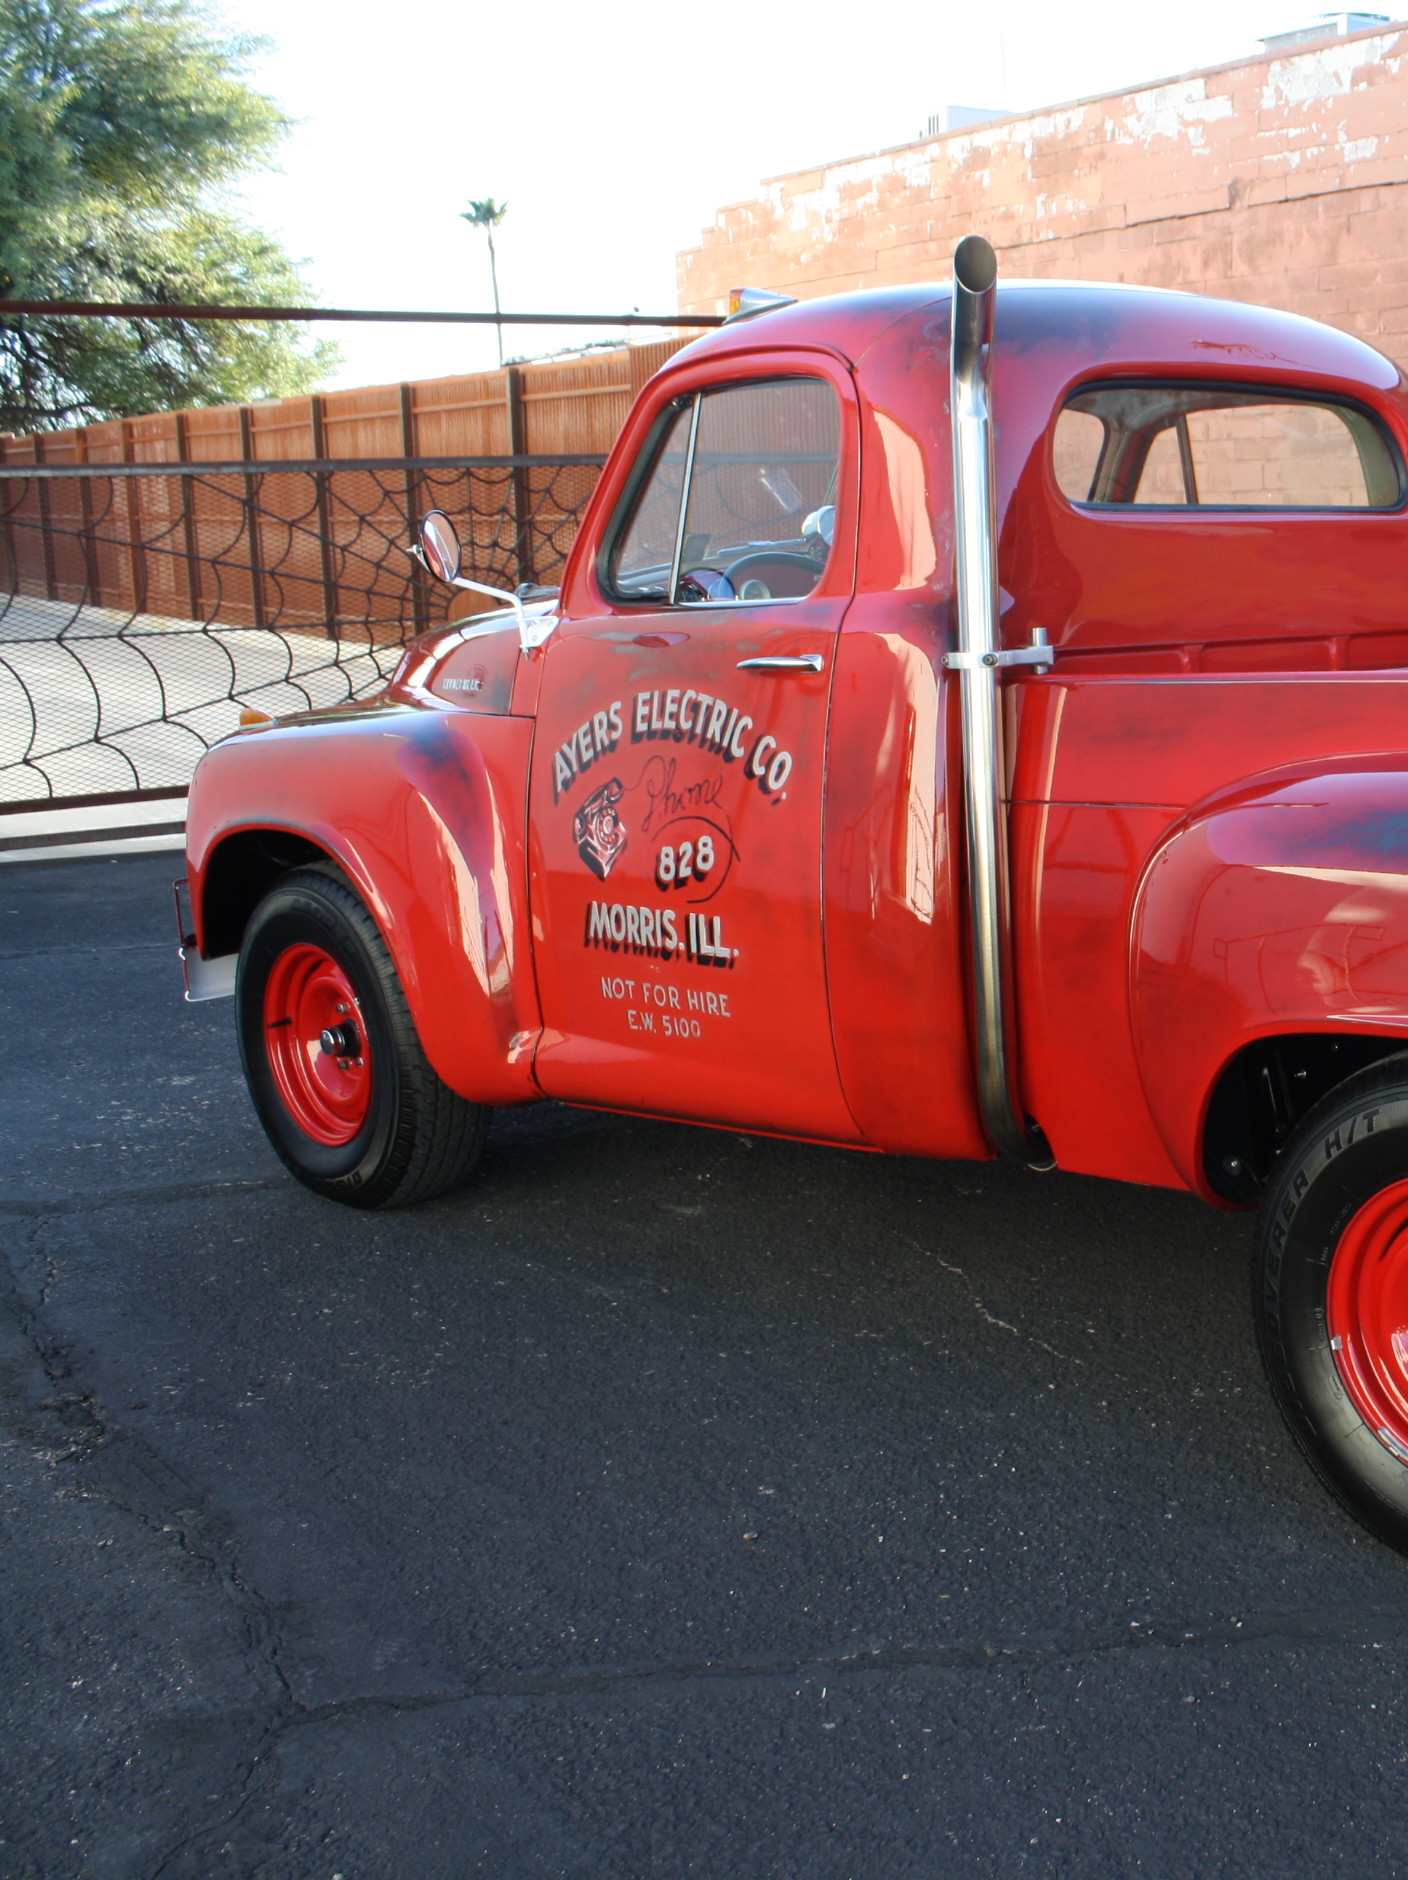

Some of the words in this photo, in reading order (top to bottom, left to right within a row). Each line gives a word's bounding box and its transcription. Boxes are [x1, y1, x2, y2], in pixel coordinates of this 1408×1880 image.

[552, 701, 623, 800] AYERS
[632, 689, 753, 763] ELECTRIC
[748, 735, 793, 802] CO.
[656, 834, 715, 890] 828
[688, 912, 741, 968] ILL.
[601, 976, 636, 1002] NOT
[643, 983, 681, 1010] FOR
[687, 990, 731, 1018] HIRE
[662, 1014, 701, 1037] 5100
[1322, 1107, 1382, 1160] H/T
